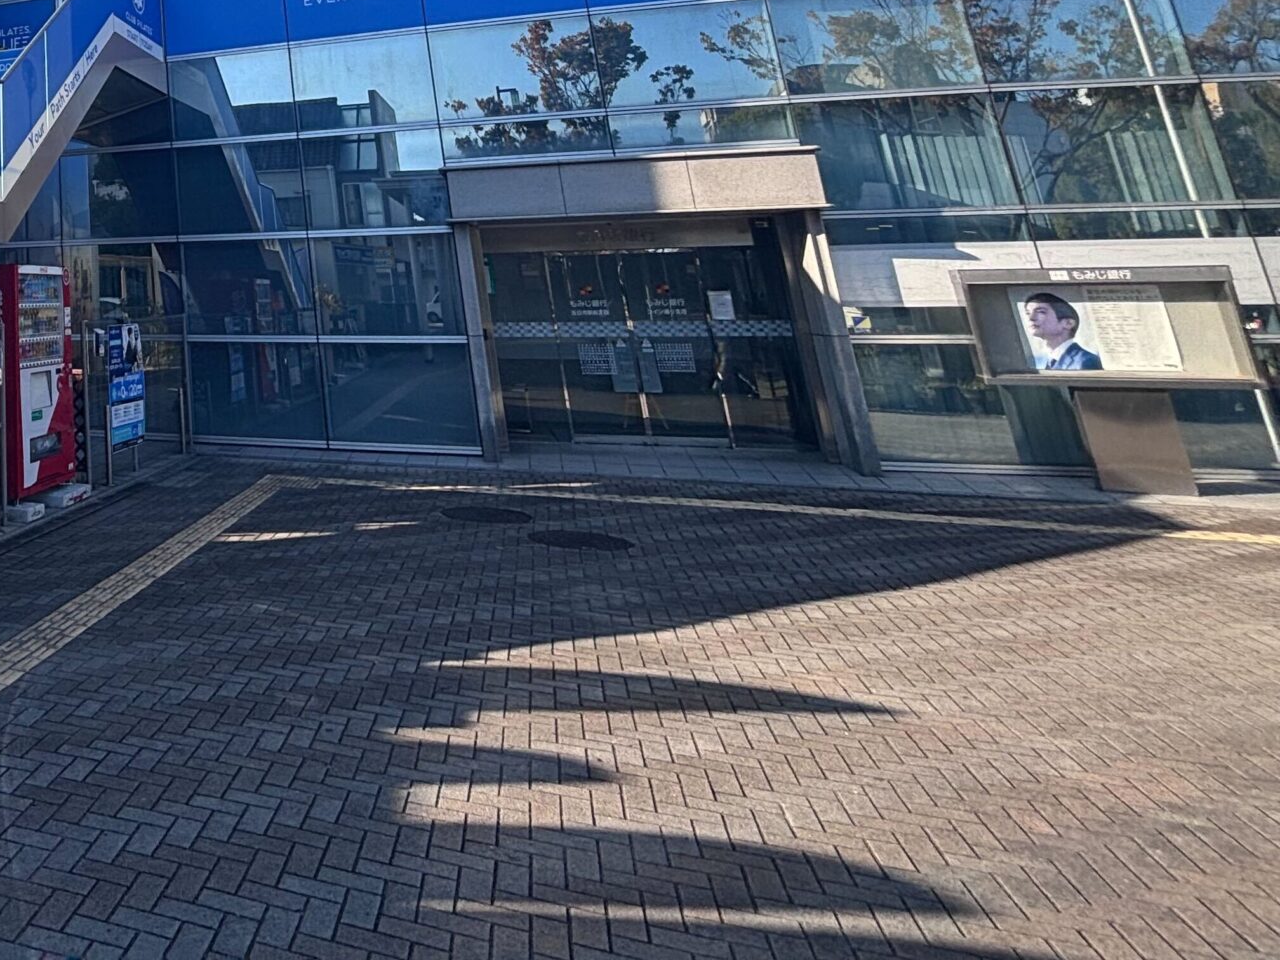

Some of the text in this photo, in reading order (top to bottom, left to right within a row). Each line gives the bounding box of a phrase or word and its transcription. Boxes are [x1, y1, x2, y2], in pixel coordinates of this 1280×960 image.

[28, 44, 99, 149] Your Path Starts Here
